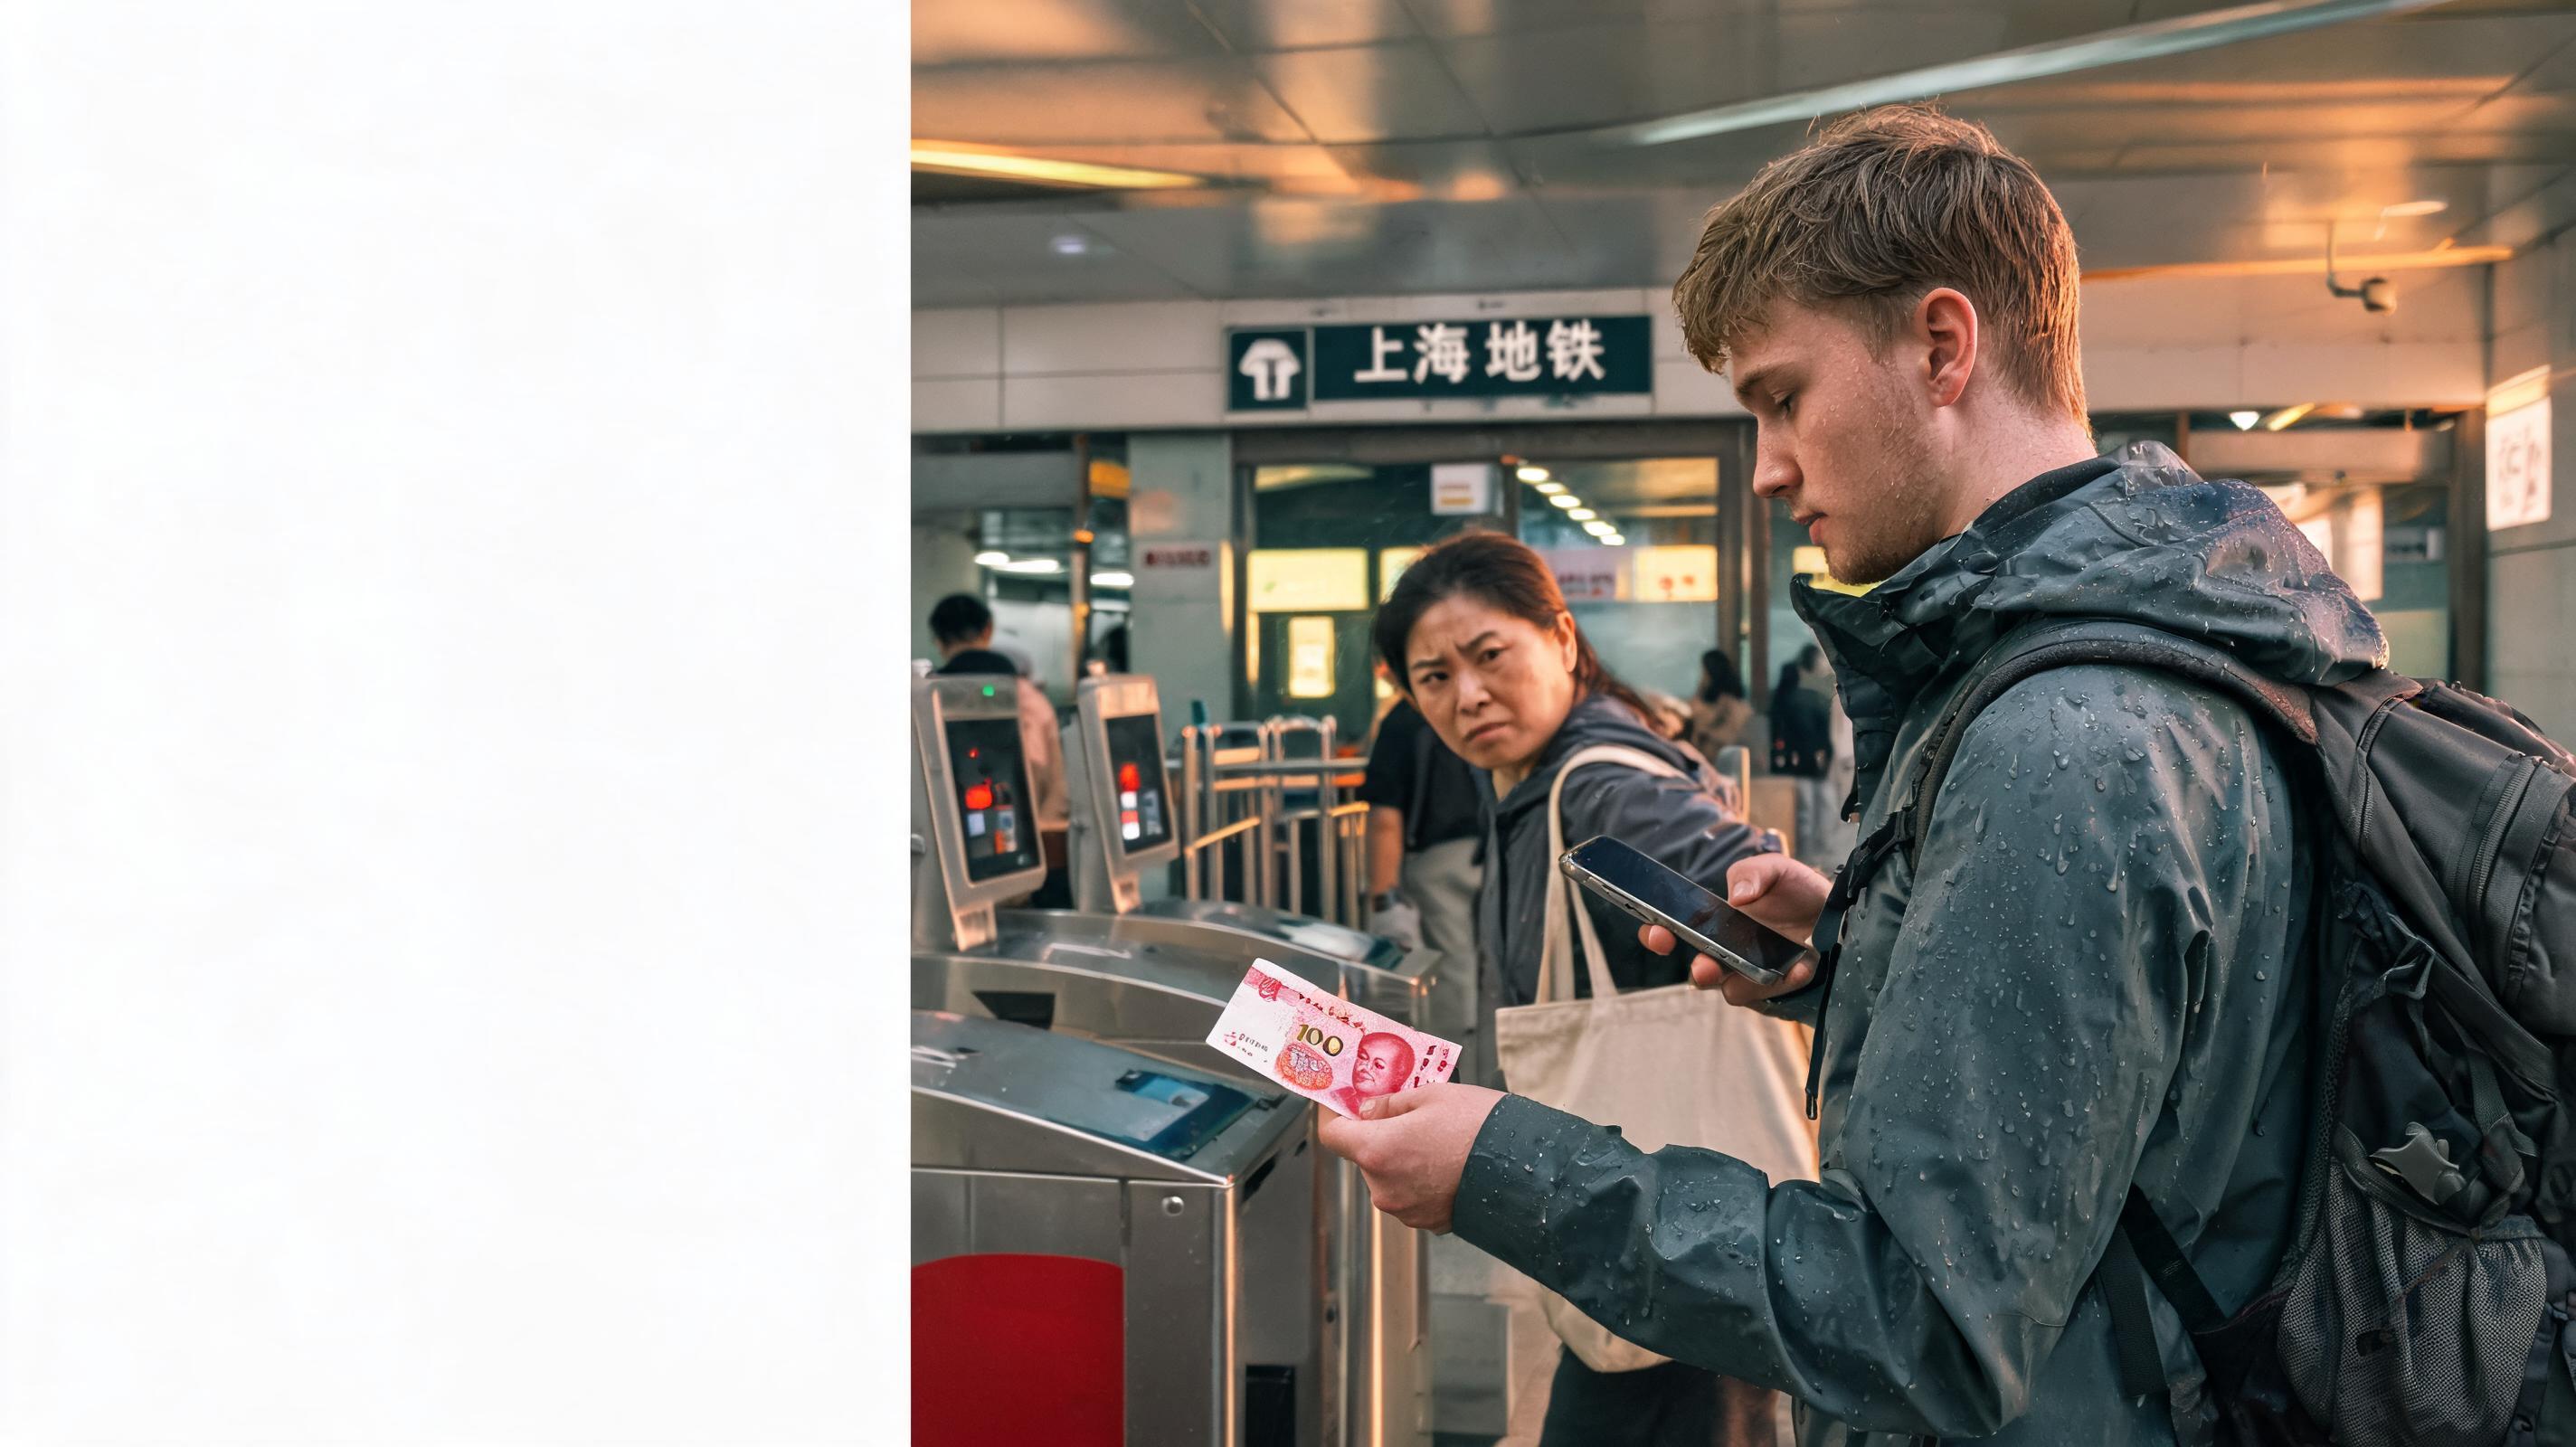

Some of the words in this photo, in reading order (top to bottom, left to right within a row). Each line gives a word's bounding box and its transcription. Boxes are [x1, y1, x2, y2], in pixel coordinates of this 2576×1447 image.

[1354, 319, 1605, 383] 上海地铁
[1296, 1024, 1344, 1057] 100
